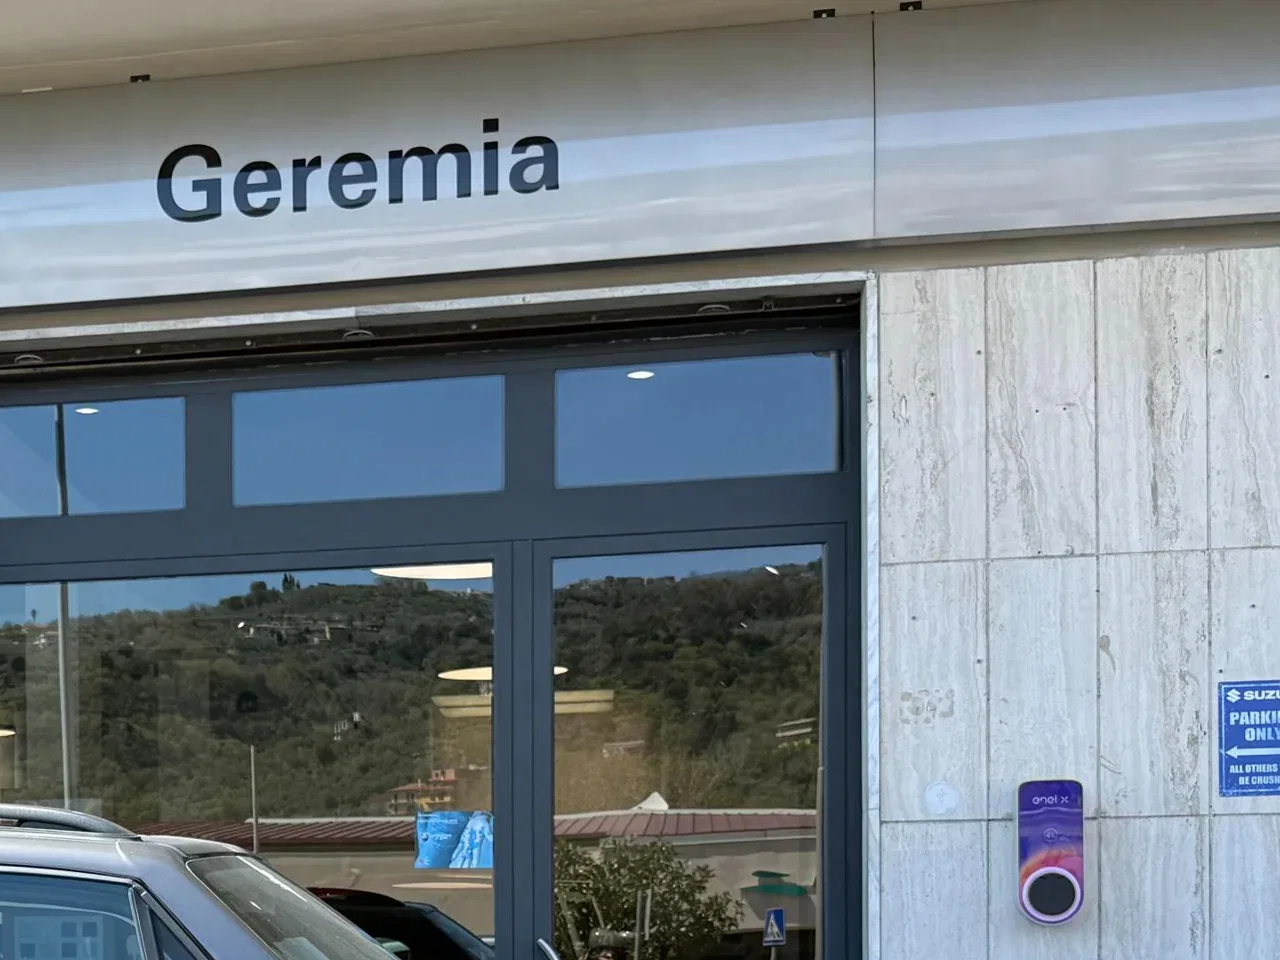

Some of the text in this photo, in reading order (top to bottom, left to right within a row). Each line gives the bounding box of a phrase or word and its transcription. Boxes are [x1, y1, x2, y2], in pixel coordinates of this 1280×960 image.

[157, 118, 559, 223] Geremia
[1229, 710, 1280, 726] PARKI
[1229, 763, 1278, 774] ALL OTHERS
[1238, 776, 1250, 785] BE
[1032, 794, 1058, 805] enel
